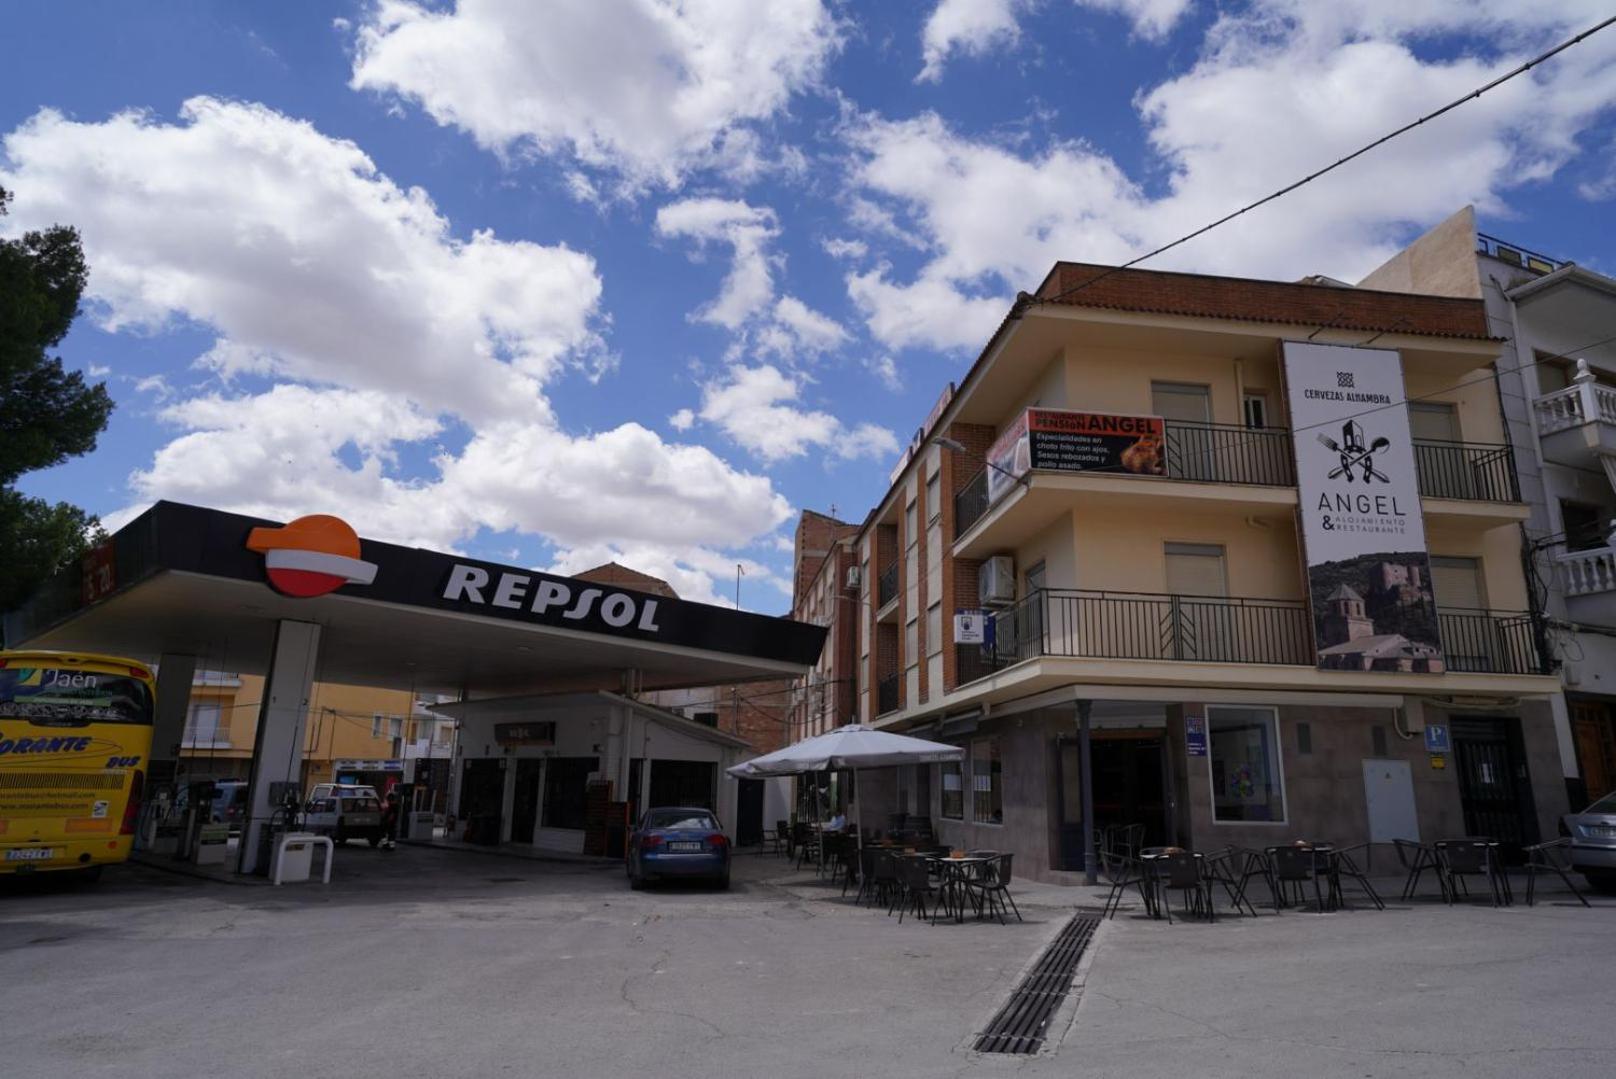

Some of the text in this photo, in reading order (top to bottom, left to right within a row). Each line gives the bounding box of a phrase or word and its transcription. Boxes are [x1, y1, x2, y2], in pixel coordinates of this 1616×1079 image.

[1304, 389, 1391, 404] CERVEZAS ALHAMBRA
[1088, 415, 1156, 433] ANGEL
[1318, 492, 1406, 516] ANGEL
[1322, 515, 1335, 531] &
[1336, 516, 1405, 526] ALOJAMIENTO
[1337, 524, 1405, 534] RESTAURANTE
[442, 564, 660, 632] REPSOL
[45, 668, 97, 689] Jaén
[0, 734, 92, 755] ORANTE
[105, 756, 140, 769] BUS
